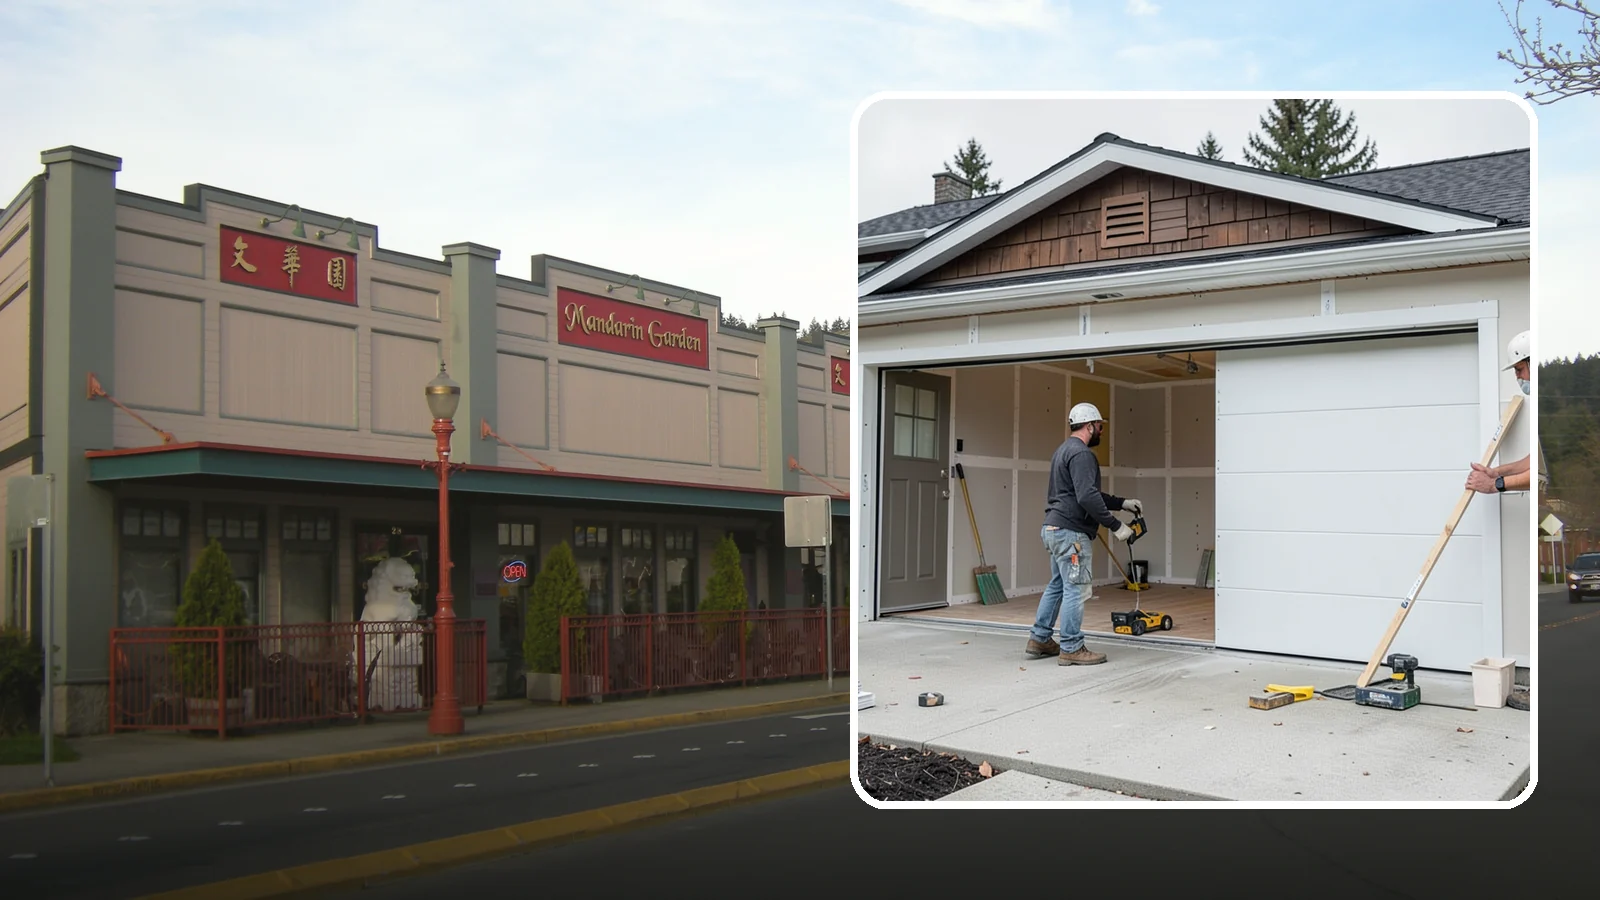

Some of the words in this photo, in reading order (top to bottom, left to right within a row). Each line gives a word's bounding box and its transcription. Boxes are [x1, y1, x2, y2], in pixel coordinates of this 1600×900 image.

[564, 302, 644, 341] Mandarin
[648, 320, 702, 352] Garden
[503, 565, 527, 578] OPEN
